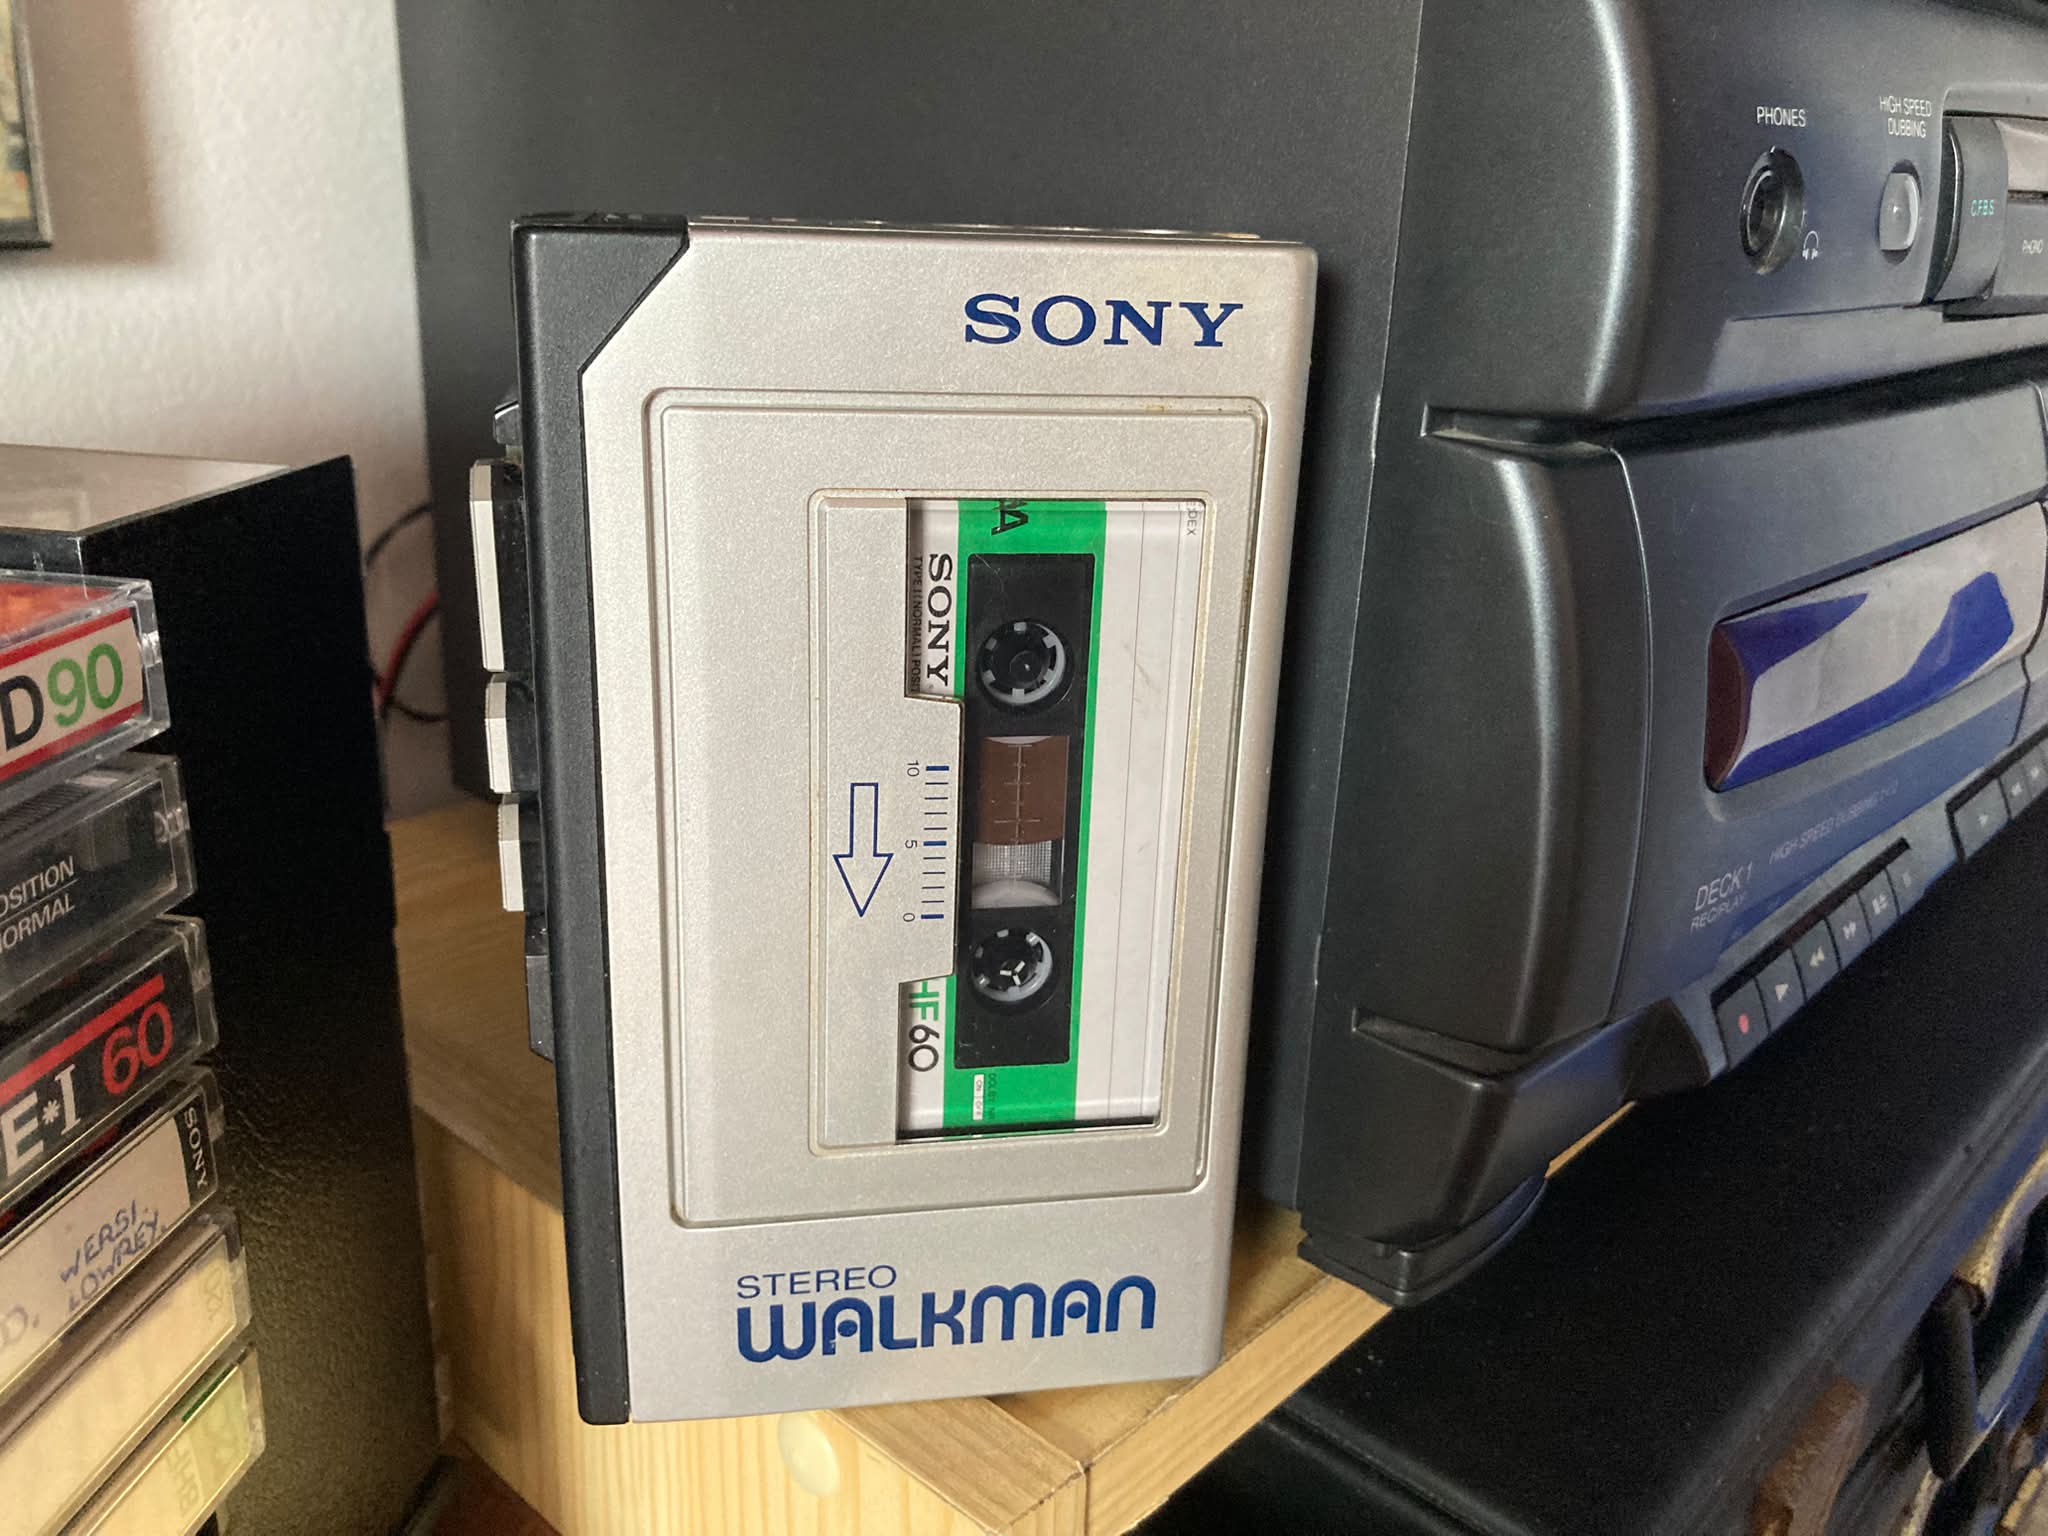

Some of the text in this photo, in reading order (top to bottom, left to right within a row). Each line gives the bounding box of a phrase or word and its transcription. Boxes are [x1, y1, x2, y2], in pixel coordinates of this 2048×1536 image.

[1756, 105, 1807, 128] PHONES
[1879, 95, 1932, 117] HIGH SPEED
[1887, 117, 1927, 138] DUBBING
[964, 293, 1243, 348] SONY
[911, 556, 923, 586] TYPE
[927, 553, 953, 686] SONY
[906, 760, 920, 777] 10
[904, 839, 918, 849] 5
[1694, 867, 1745, 912] DECK
[0, 893, 76, 954] ORMAL
[902, 912, 916, 923] 0
[102, 1001, 174, 1095] 60
[183, 1107, 209, 1190] SONY
[736, 1264, 897, 1299] STEREO
[736, 1275, 1157, 1363] WALKMAN
